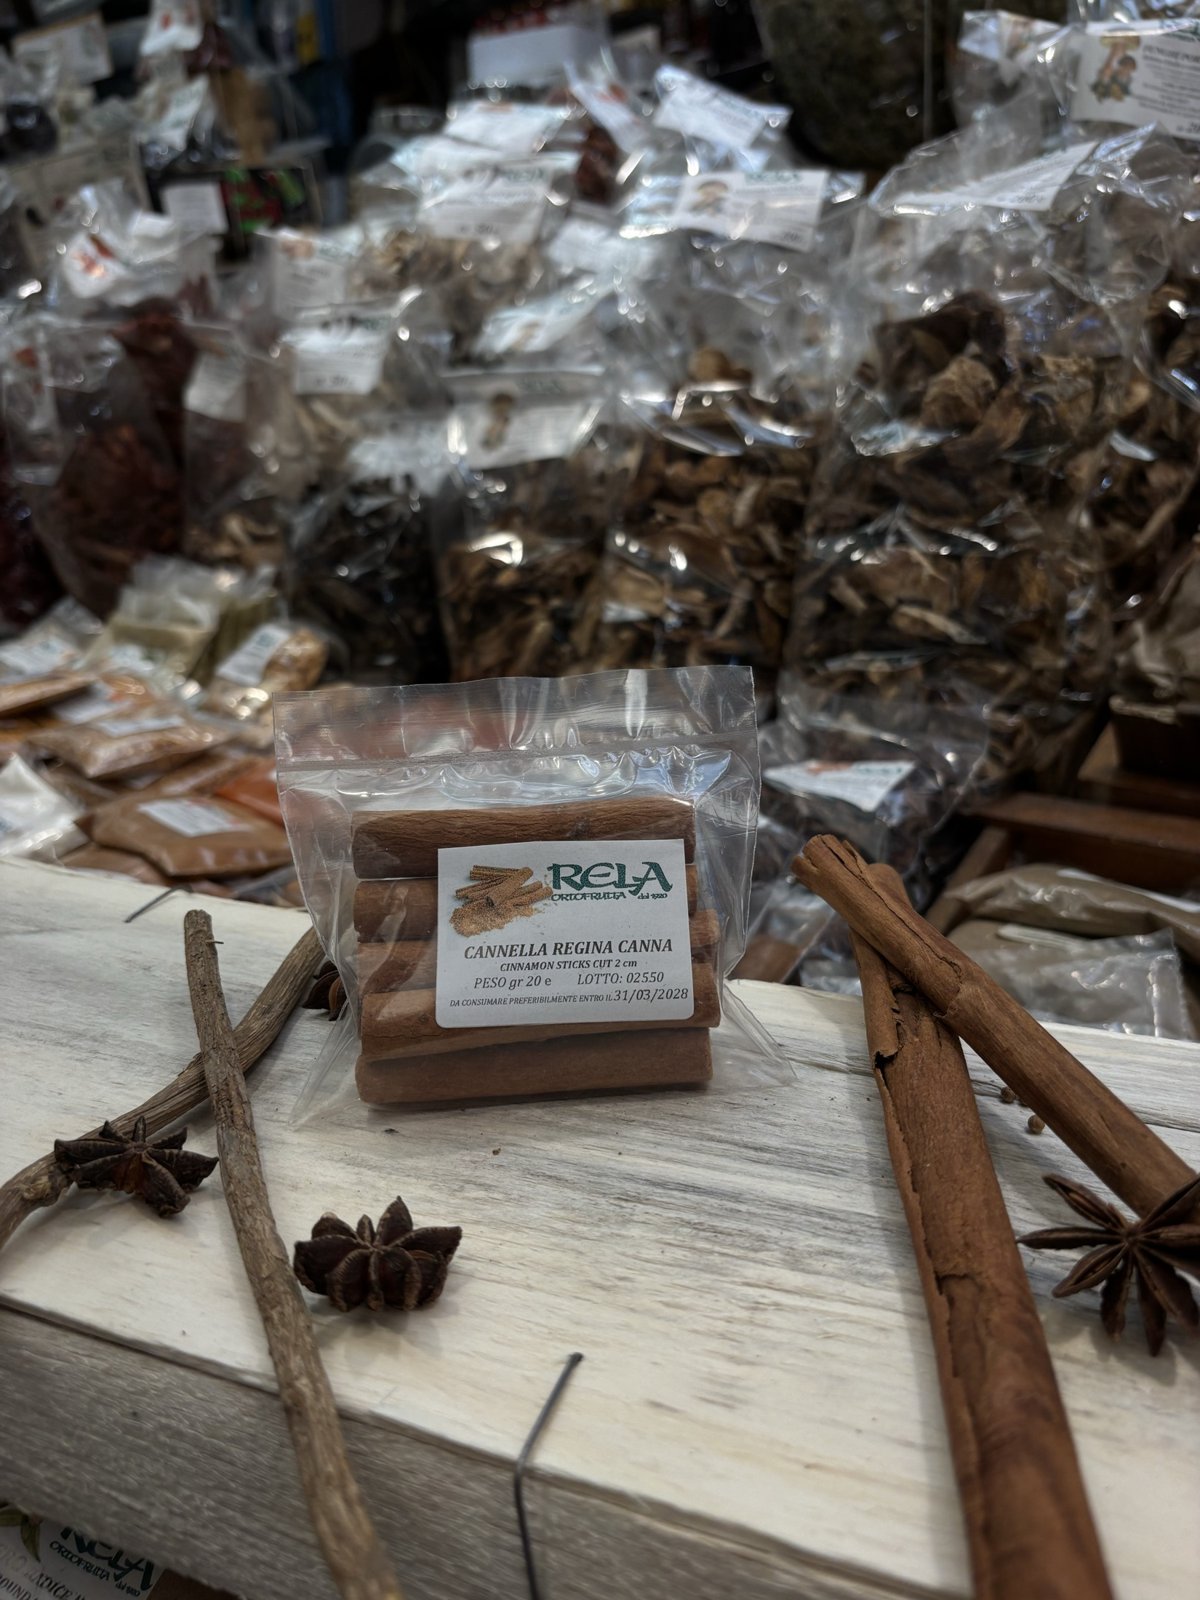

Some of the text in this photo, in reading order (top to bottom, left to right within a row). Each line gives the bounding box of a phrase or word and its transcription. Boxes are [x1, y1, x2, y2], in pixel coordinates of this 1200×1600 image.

[547, 862, 673, 896] RELA
[551, 892, 626, 902] ORTOFRUTTA
[464, 939, 672, 959] CANNELLA REGINA CANNA
[500, 961, 554, 972] CINNAMON
[556, 960, 591, 969] STICKS
[593, 959, 613, 968] CUT
[615, 959, 620, 967] 2
[474, 975, 551, 990] PESO gr 20 e
[577, 972, 664, 985] LOTTO: 02550
[462, 998, 507, 1006] CONSUMARE
[509, 995, 577, 1004] PREFERIBILMENTE
[614, 988, 688, 1003] 31/03/2028
